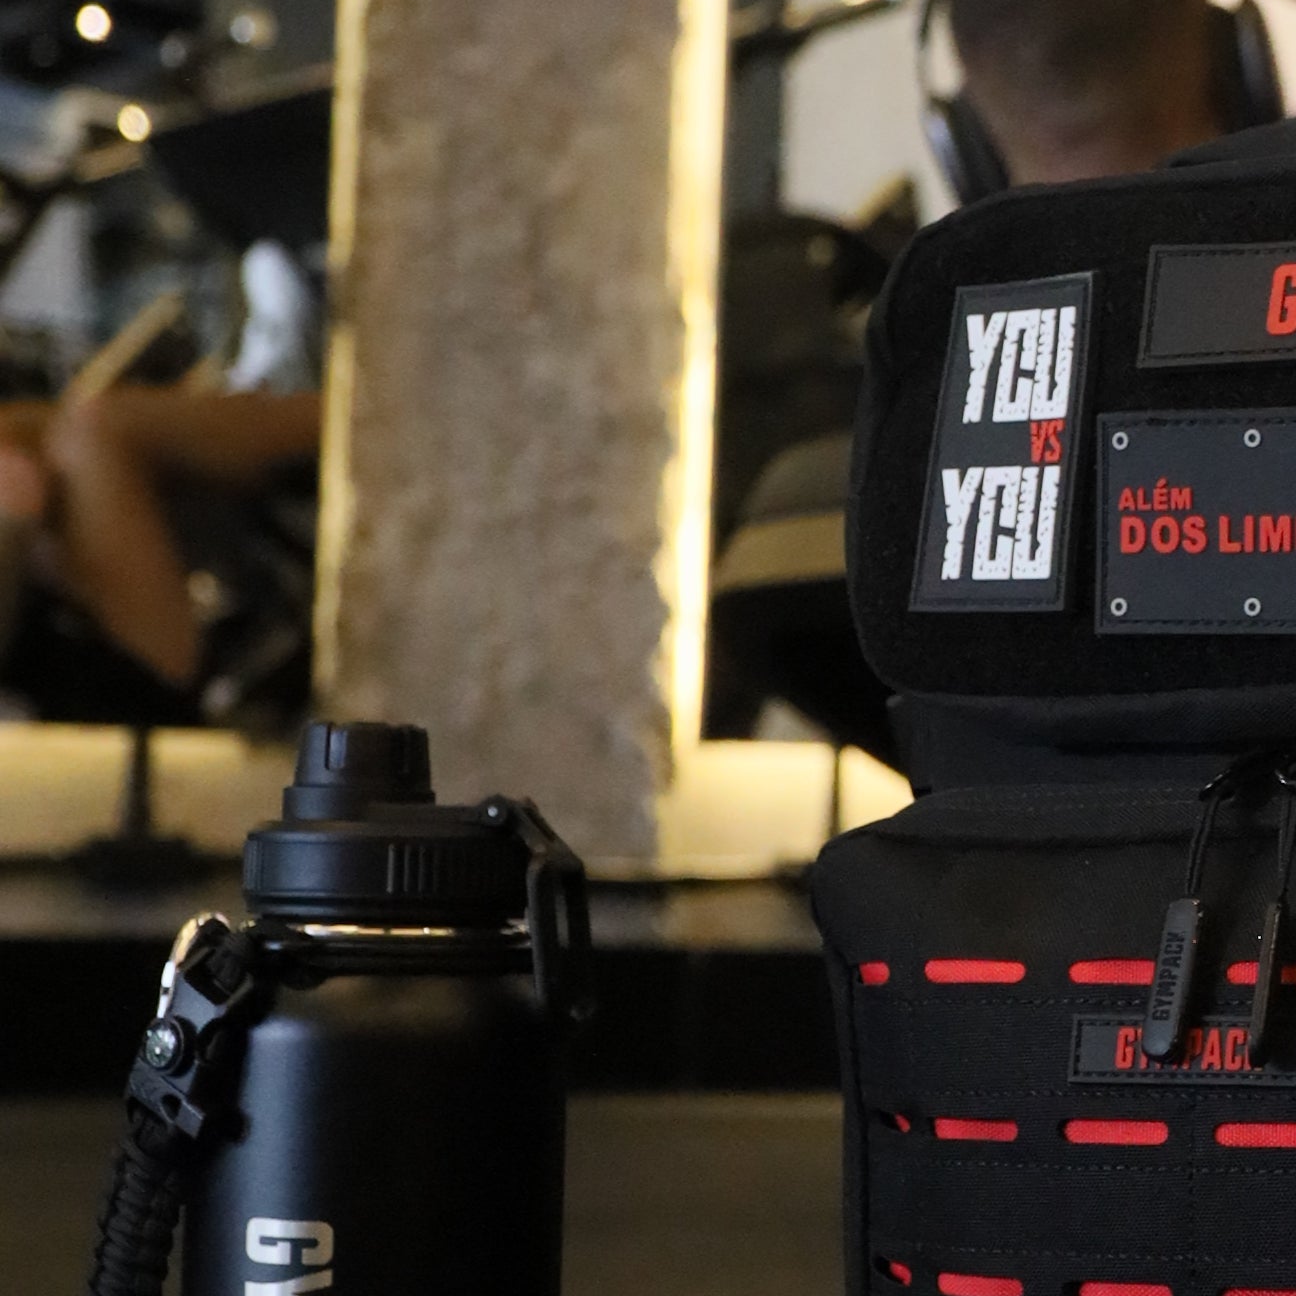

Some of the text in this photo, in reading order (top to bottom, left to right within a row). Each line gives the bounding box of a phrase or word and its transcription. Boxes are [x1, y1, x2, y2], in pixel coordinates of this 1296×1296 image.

[962, 305, 1077, 424] YOU
[1029, 418, 1066, 464] VS
[1117, 477, 1193, 512] ALÉM
[941, 465, 1061, 581] YOU
[1119, 514, 1208, 555] DOS
[1152, 931, 1187, 1022] GYMPACK
[1114, 1025, 1263, 1072] GPAC
